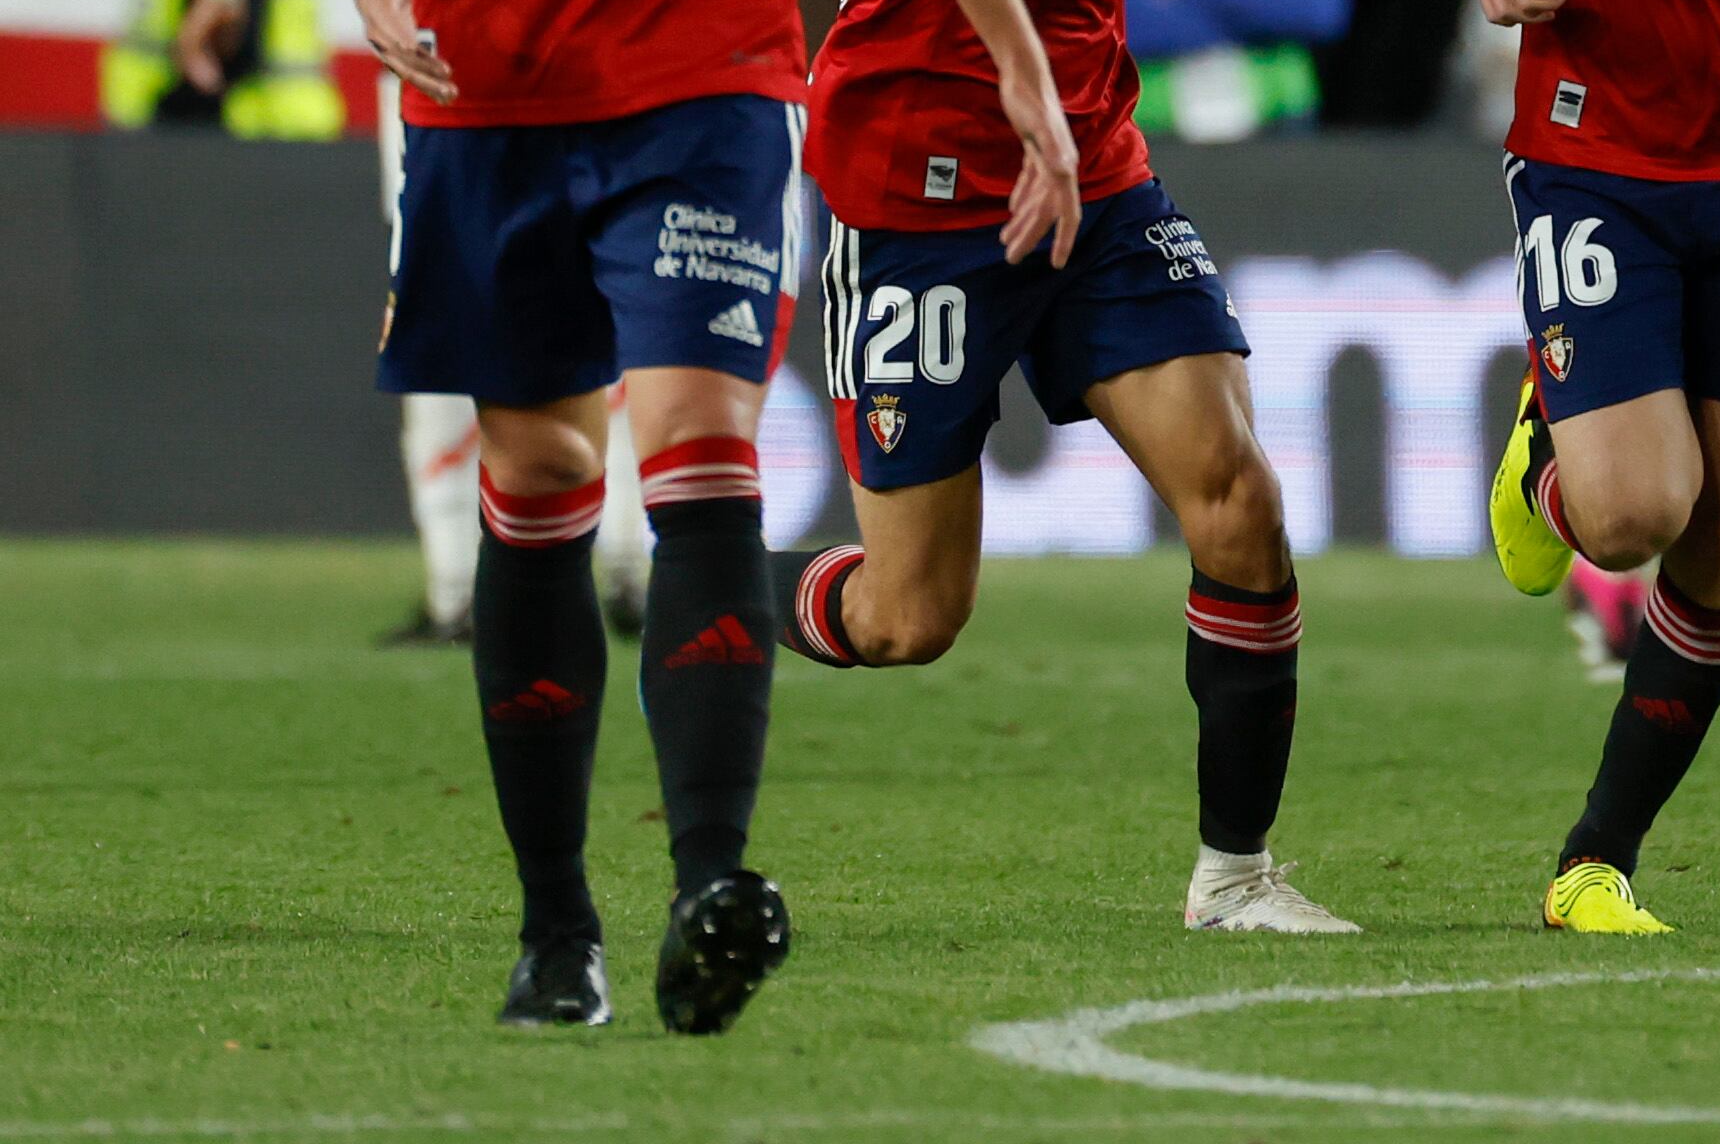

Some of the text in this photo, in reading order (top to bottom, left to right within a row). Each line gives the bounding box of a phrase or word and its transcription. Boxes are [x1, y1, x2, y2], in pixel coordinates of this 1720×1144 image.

[1168, 260, 1195, 281] de
[1524, 214, 1618, 313] 16
[864, 285, 967, 386] 20
